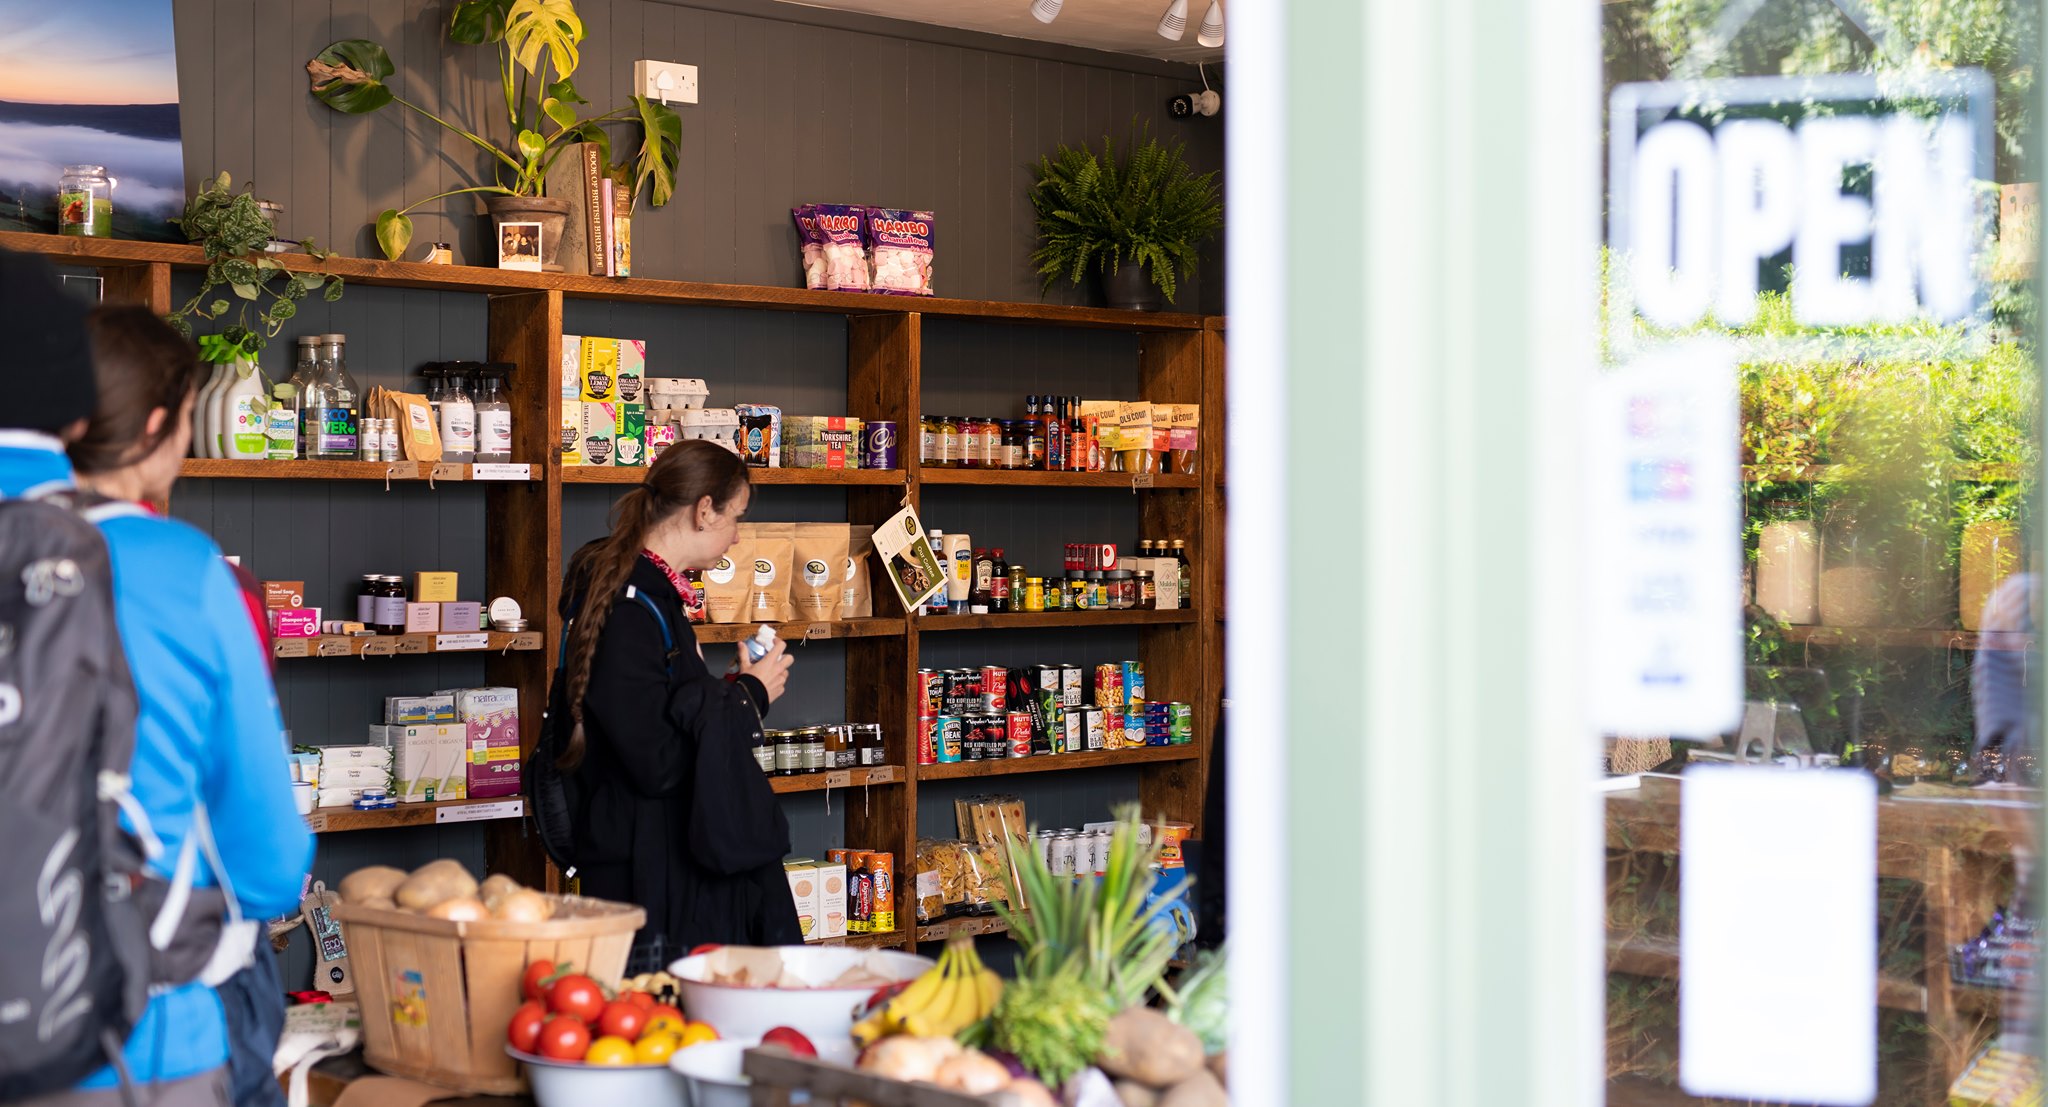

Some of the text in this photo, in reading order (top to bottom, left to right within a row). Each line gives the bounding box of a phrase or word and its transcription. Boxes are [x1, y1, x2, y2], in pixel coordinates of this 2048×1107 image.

[589, 151, 603, 252] BOOK OF BRITISH BIRDS
[820, 214, 858, 231] HARIBO
[1633, 112, 1975, 328] OPEN
[873, 217, 928, 237] HARIBO
[879, 233, 928, 246] Chamallows
[321, 408, 348, 421] ECO
[1120, 413, 1131, 424] OLY
[321, 421, 349, 434] VER
[821, 431, 851, 442] YORKSHIRE
[831, 441, 842, 450] TEA
[917, 545, 935, 578] Our Coffee
[473, 693, 514, 704] natracare
[324, 938, 341, 951] ECO
